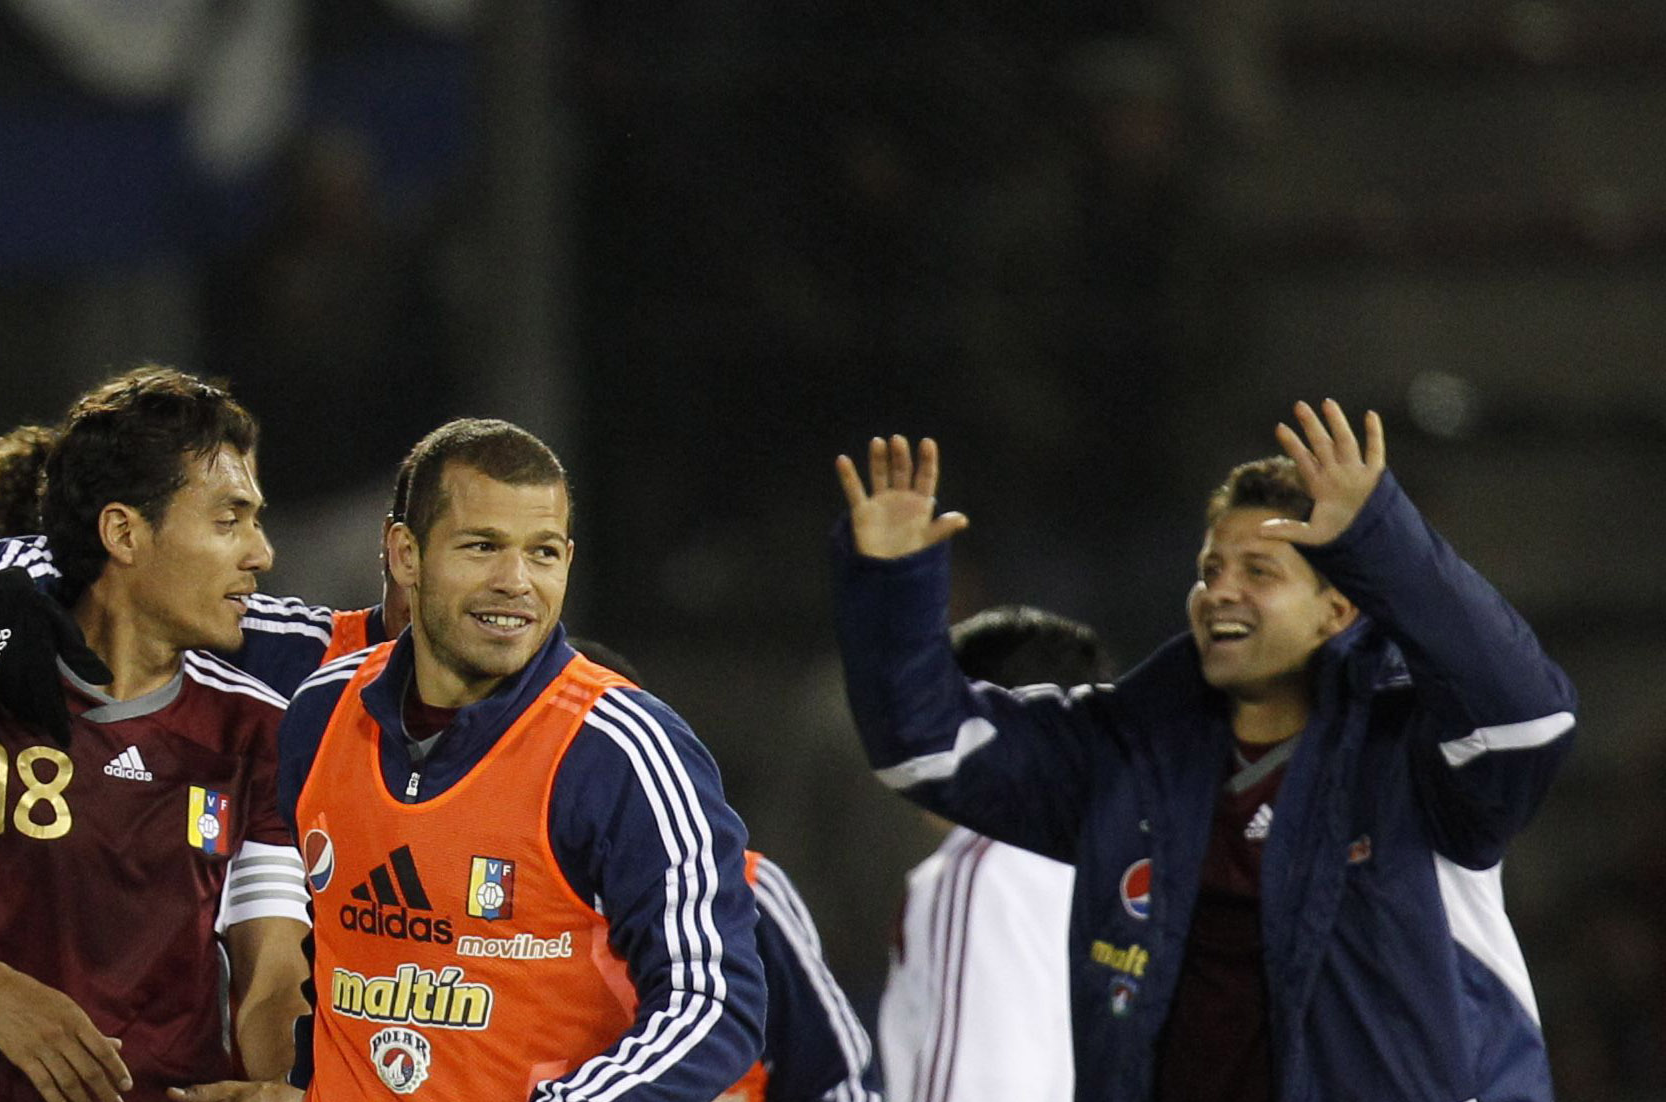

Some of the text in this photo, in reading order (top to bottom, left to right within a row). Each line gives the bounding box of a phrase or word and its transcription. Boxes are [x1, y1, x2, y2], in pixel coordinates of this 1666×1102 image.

[103, 763, 153, 782] adidas
[339, 904, 454, 945] adidas
[456, 931, 573, 960] movilnet
[371, 1030, 429, 1062] POLAR
